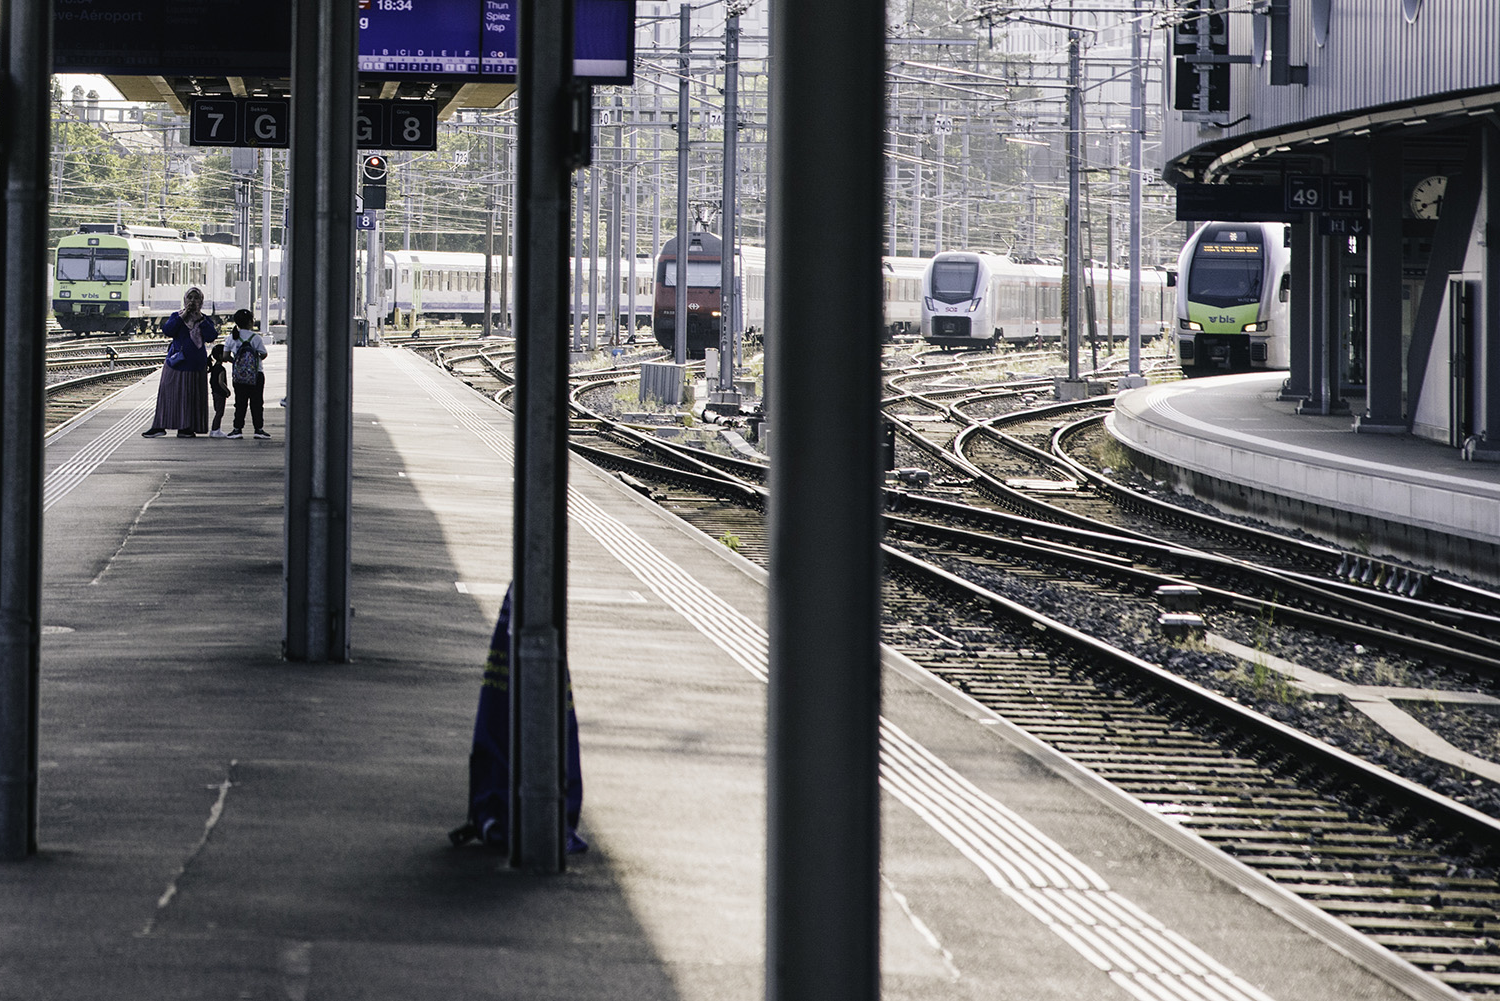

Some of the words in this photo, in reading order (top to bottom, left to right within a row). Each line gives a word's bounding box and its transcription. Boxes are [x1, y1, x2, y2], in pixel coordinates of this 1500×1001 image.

[377, 0, 412, 11] 18:34
[487, 1, 509, 10] Thun
[486, 12, 510, 21] Spiez
[486, 23, 505, 32] Visp
[207, 113, 224, 137] 7
[254, 114, 277, 139] G
[356, 116, 373, 140] G
[402, 117, 421, 142] 8
[1293, 189, 1318, 205] 49
[1339, 190, 1353, 206] H
[362, 215, 370, 227] 8
[1219, 315, 1236, 324] bls
